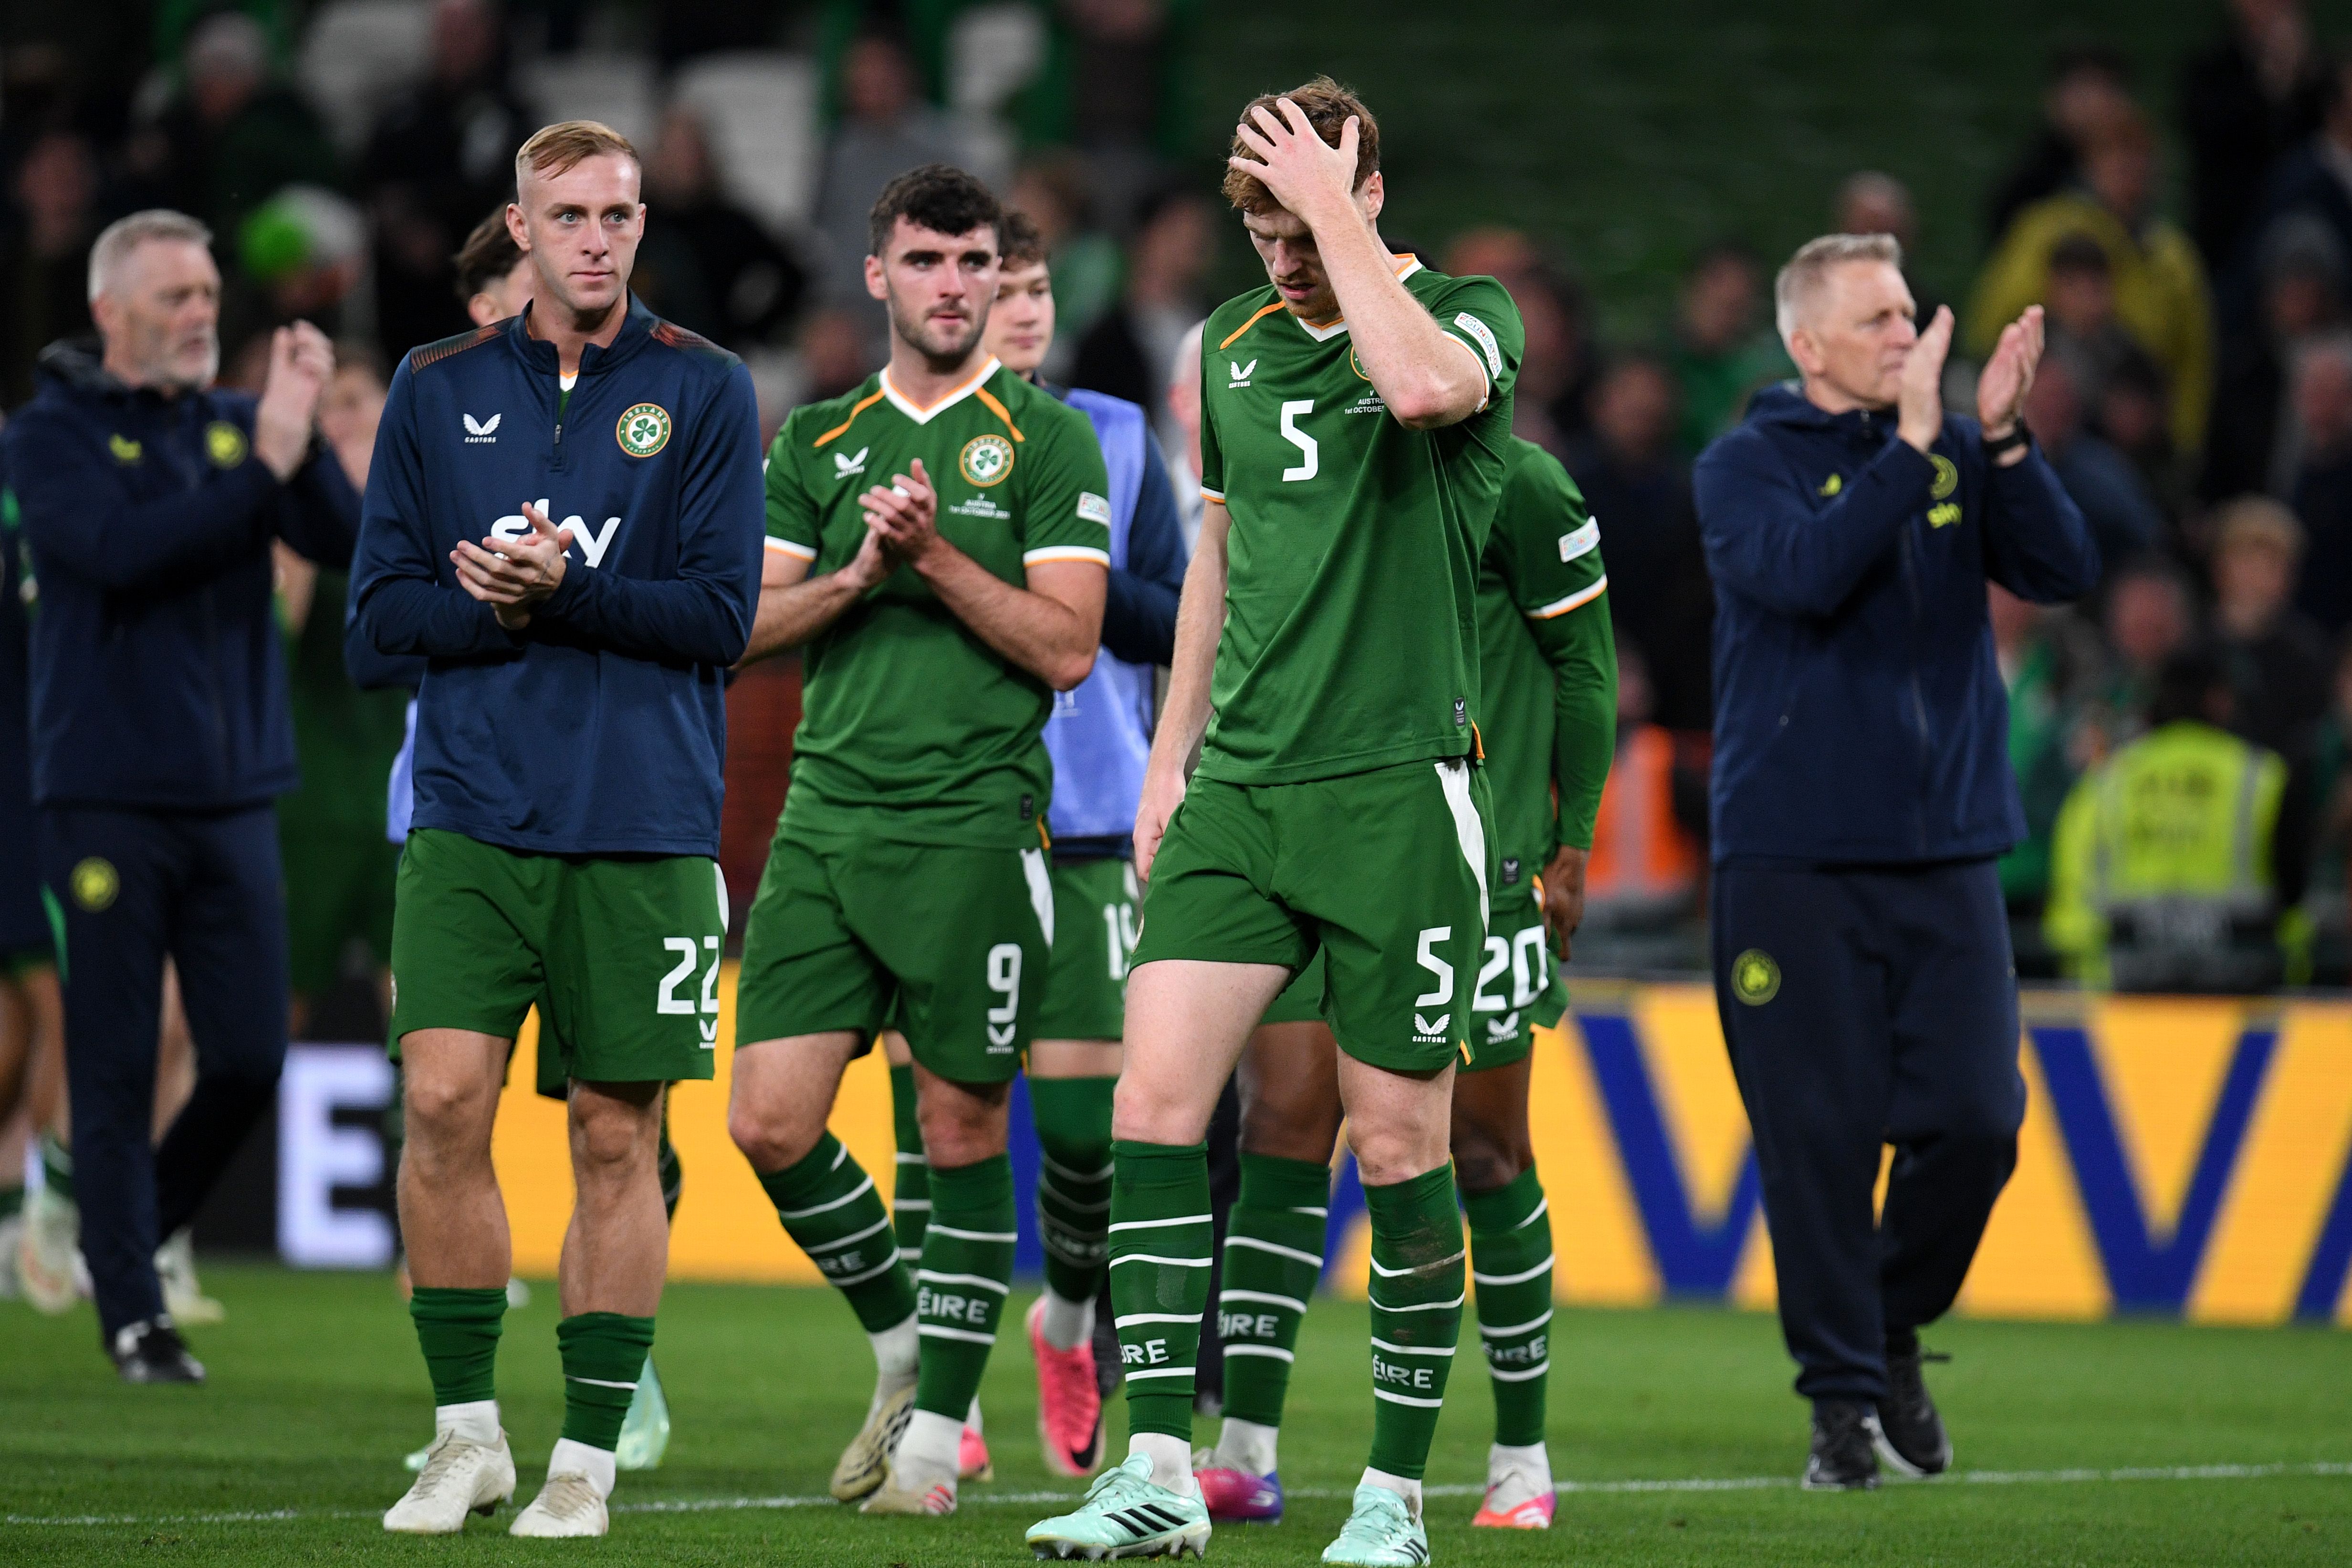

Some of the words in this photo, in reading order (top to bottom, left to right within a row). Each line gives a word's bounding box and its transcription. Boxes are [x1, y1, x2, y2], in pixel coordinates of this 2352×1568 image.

[1459, 316, 1500, 374] FOUNDATION
[623, 406, 668, 424] IRELAND
[1358, 397, 1384, 405] AUSTRI
[1280, 399, 1318, 482] 5
[986, 942, 1023, 1024] 9
[1415, 926, 1453, 1007] 5
[1472, 925, 1549, 1012] 20
[917, 1286, 990, 1325] ÉIRE
[1119, 1338, 1170, 1364] IRE
[1372, 1354, 1433, 1389] ÉIRE
